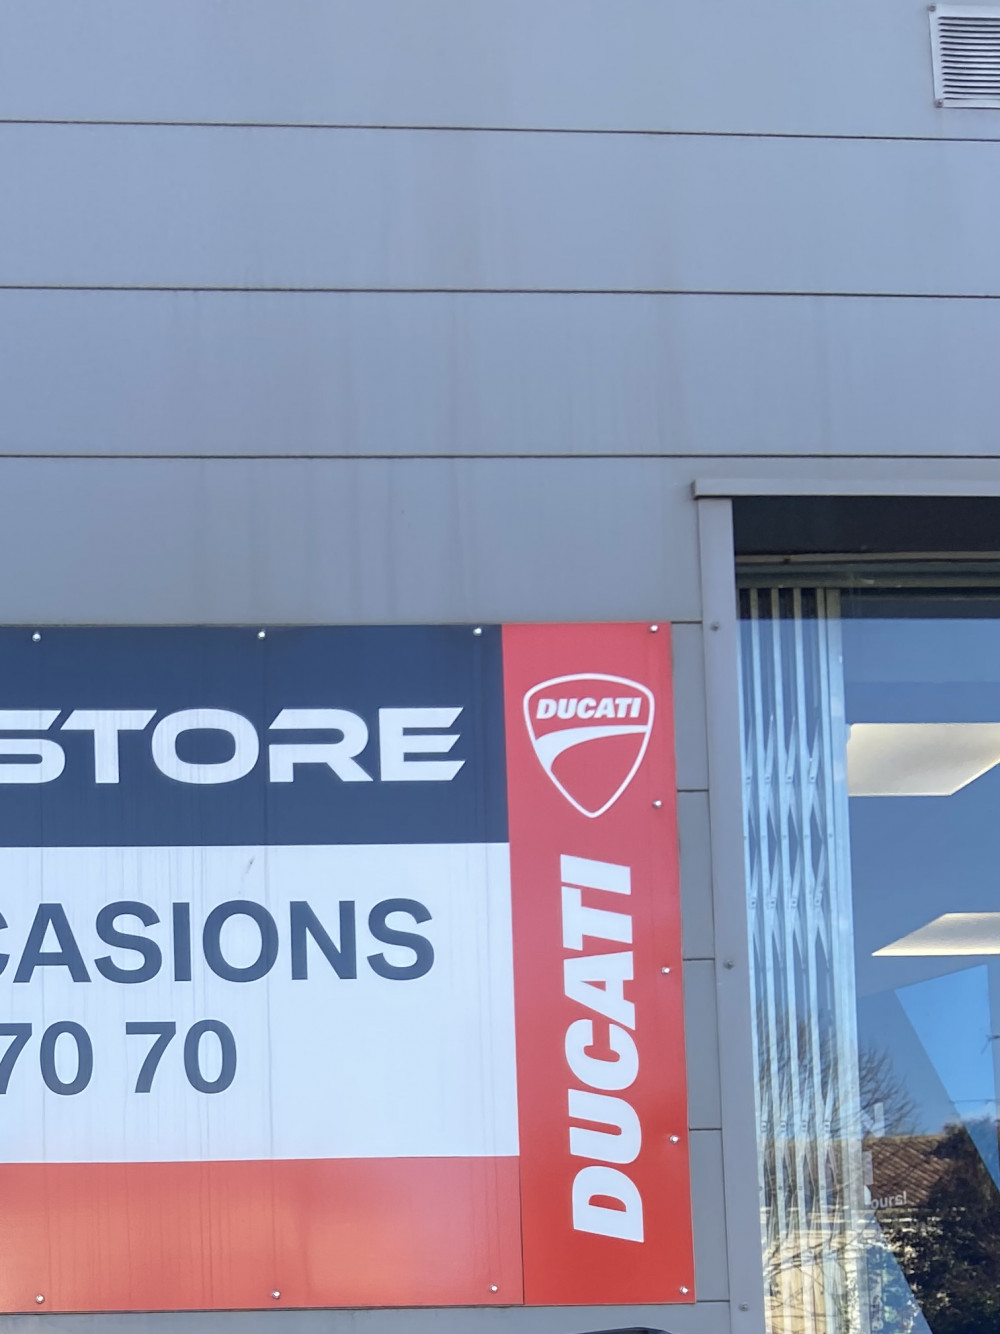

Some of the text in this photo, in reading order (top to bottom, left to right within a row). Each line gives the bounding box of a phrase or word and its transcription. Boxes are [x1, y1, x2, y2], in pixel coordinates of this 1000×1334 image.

[536, 697, 642, 719] DUCATI
[125, 1019, 237, 1094] 70
[560, 853, 645, 1243] DUCATI
